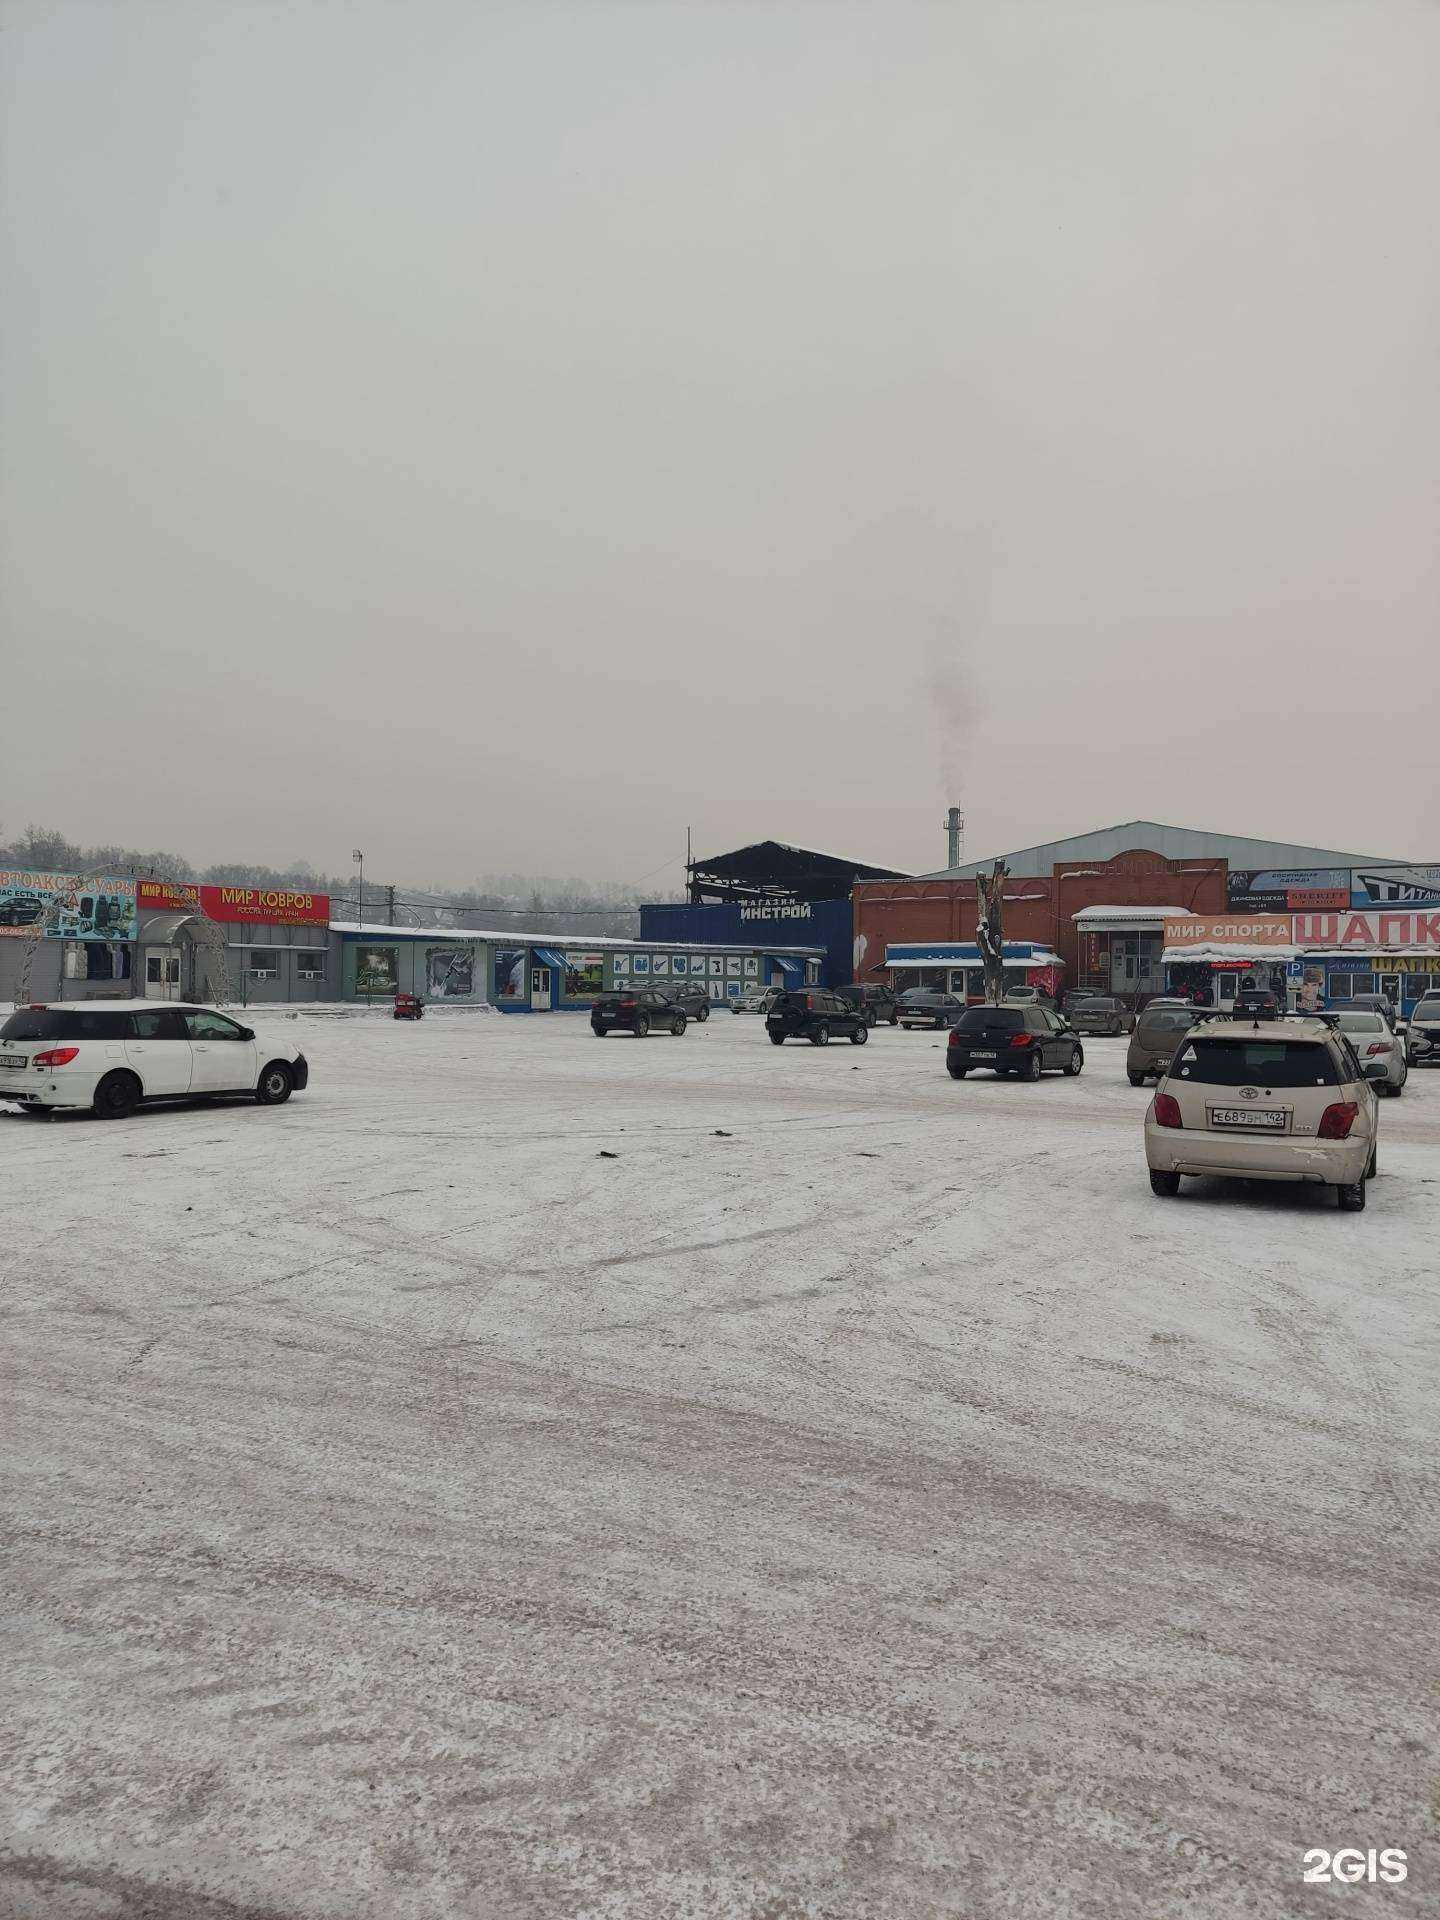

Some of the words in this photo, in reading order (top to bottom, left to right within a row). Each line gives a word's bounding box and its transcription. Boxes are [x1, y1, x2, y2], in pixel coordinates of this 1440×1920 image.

[0, 888, 12, 896] АС
[15, 890, 36, 898] ЕСТЬ
[141, 884, 161, 897] МИР
[221, 888, 253, 904] МИР
[258, 890, 312, 909] КОВРОВ
[740, 902, 812, 919] ИНСТРОЙ
[1167, 925, 1206, 938] МИР
[1212, 924, 1289, 937] СПОРТА
[1295, 915, 1440, 944] ШАПК
